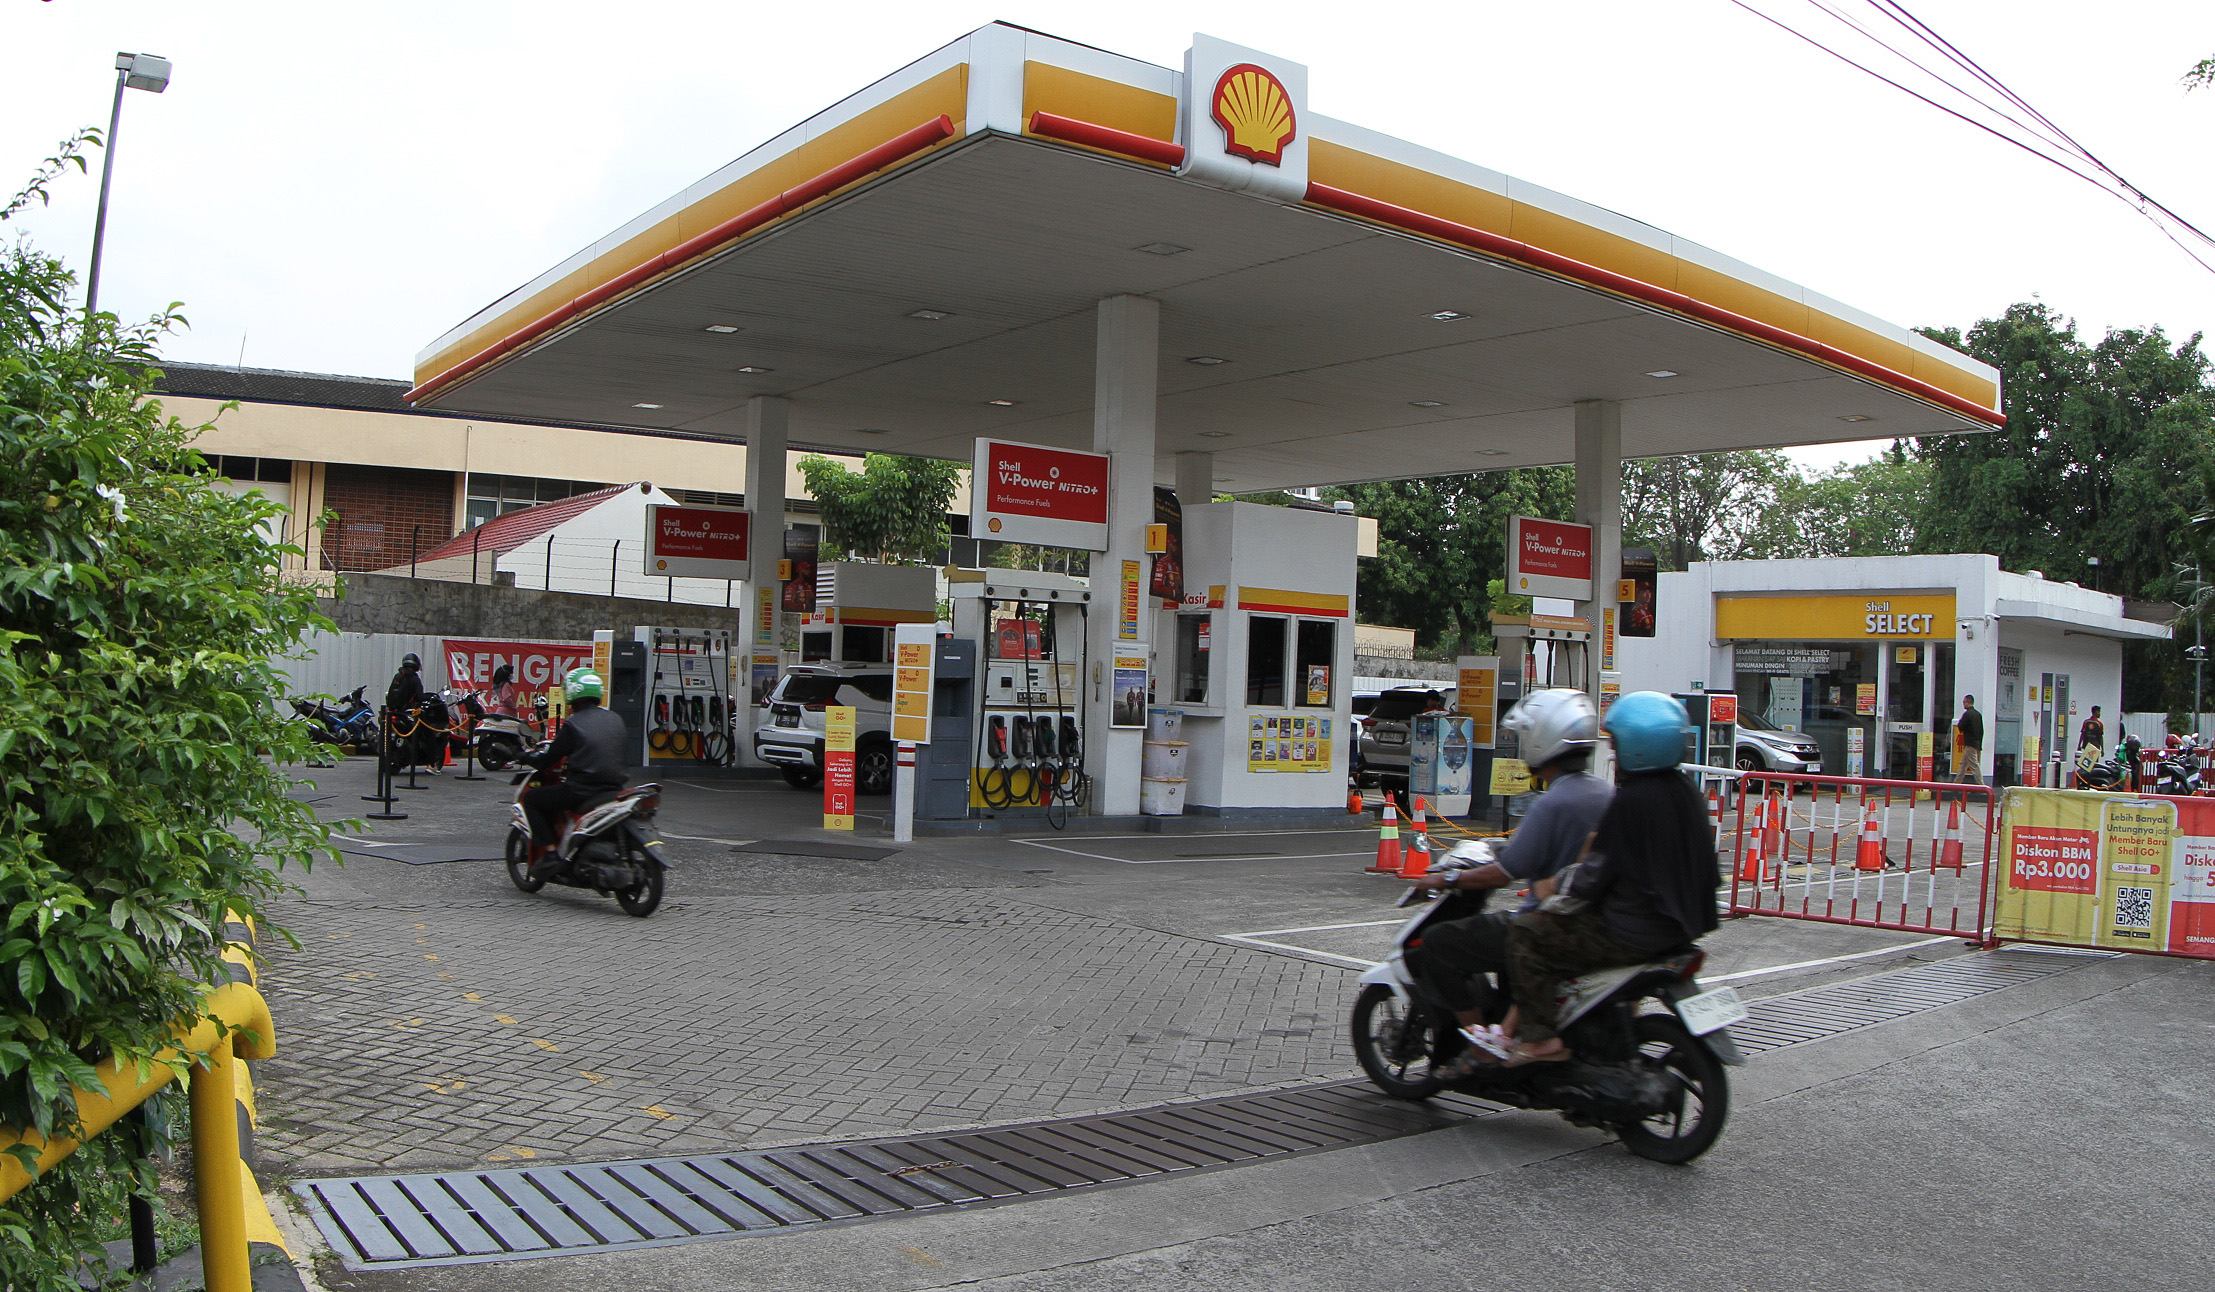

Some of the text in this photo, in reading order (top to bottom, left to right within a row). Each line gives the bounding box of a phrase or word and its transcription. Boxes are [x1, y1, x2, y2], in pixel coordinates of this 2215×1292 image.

[998, 460, 1021, 472] Shell
[998, 471, 1056, 490] V-Power
[997, 494, 1051, 508] Performance Fuels
[663, 519, 680, 527] Shell
[663, 527, 707, 539] V-Power
[1151, 531, 1157, 545] 1
[1525, 532, 1540, 541] Shell
[662, 543, 691, 551] Performance
[1525, 540, 1560, 555] V-Power
[779, 564, 785, 575] 3
[1524, 558, 1558, 569] Performance Fuels
[1621, 584, 1629, 596] 5
[1184, 592, 1207, 605] Kasir
[1865, 601, 1890, 612] Shell
[1865, 613, 1934, 635] SELECT
[1999, 655, 2020, 667] FRESH
[1999, 666, 2020, 677] COFFEE
[897, 699, 908, 707] Super
[2082, 759, 2090, 767] P
[2110, 812, 2169, 825] Lebih Banyak
[2106, 824, 2170, 837] Untungnya jadi
[2109, 834, 2168, 847] Member Baru
[2016, 843, 2092, 860] Diskon BBM
[2117, 846, 2160, 857] Shell GO+
[2015, 859, 2091, 880] Rp3.000
[2117, 864, 2147, 873] Shell Asia
[2183, 874, 2204, 883] hingga
